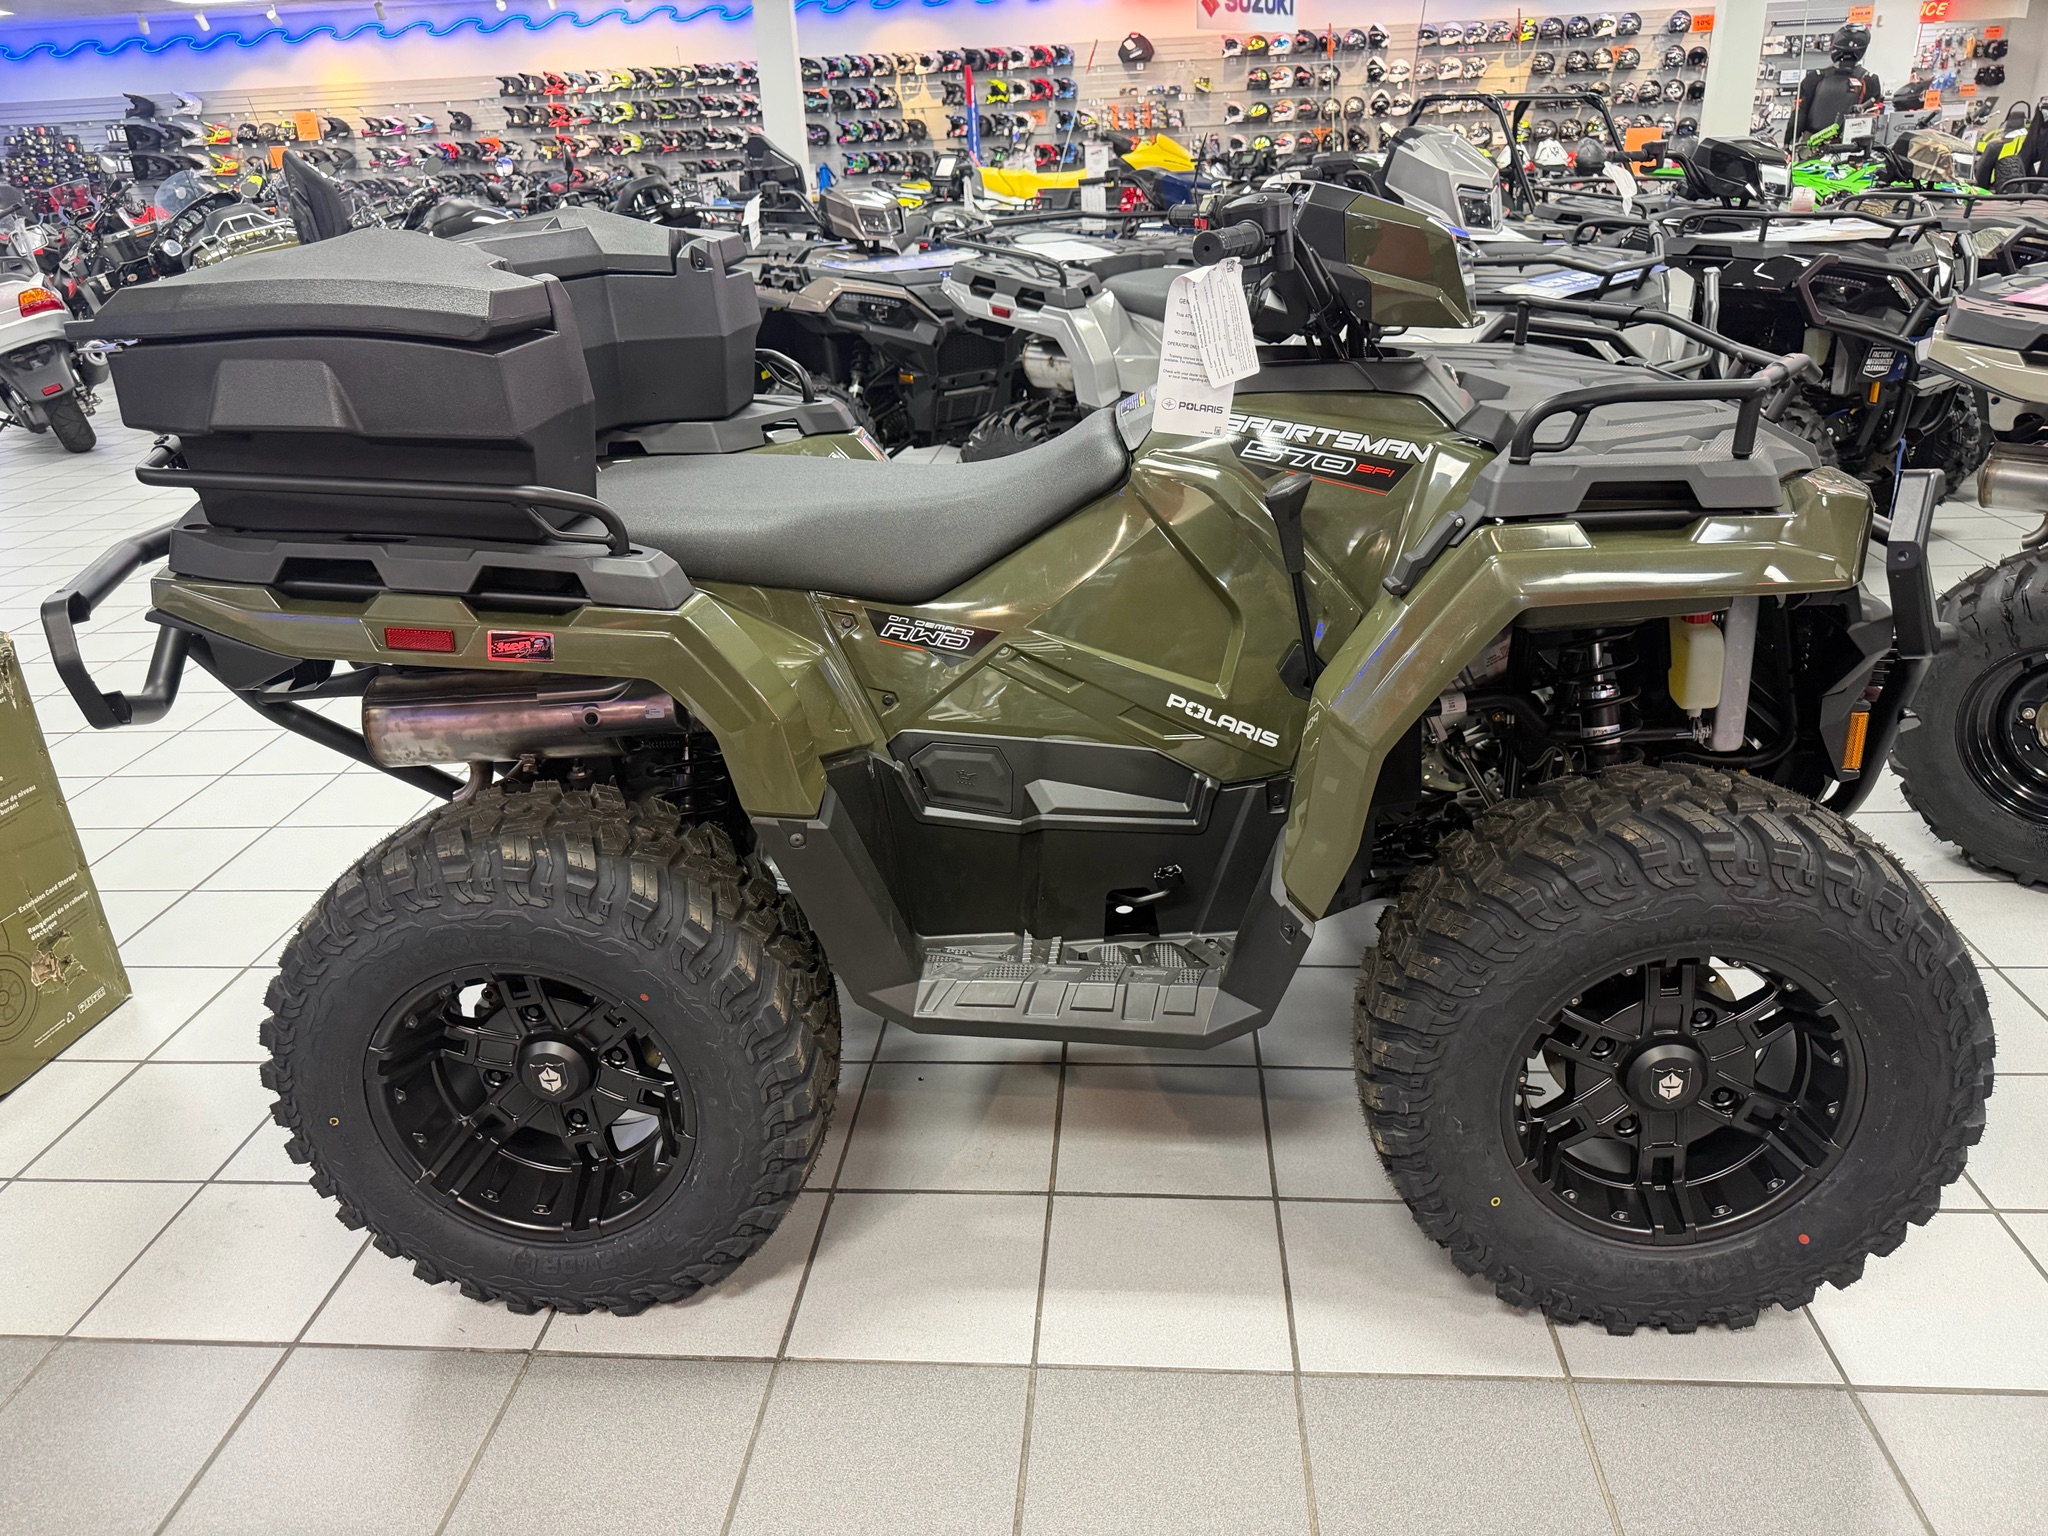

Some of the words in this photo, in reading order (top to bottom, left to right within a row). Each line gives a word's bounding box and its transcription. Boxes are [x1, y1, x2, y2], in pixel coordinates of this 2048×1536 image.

[1224, 0, 1294, 16] SUZUKI
[1920, 1, 1949, 17] ICE
[1166, 340, 1189, 348] OPERATOR
[1178, 401, 1224, 415] POLARIS
[1227, 413, 1436, 464] SPORTSMAN
[1240, 440, 1357, 477] 570
[1355, 463, 1396, 478] EFI
[880, 622, 971, 651] AWD
[914, 619, 975, 636] DEMAND
[1165, 693, 1280, 748] POLARIS
[10, 794, 18, 802] de
[18, 784, 37, 798] niveau
[0, 801, 20, 816] burant
[17, 892, 46, 914] Extension
[45, 883, 59, 896] Cord
[58, 872, 78, 888] Storage
[57, 907, 65, 915] de
[69, 890, 89, 907] rallonge
